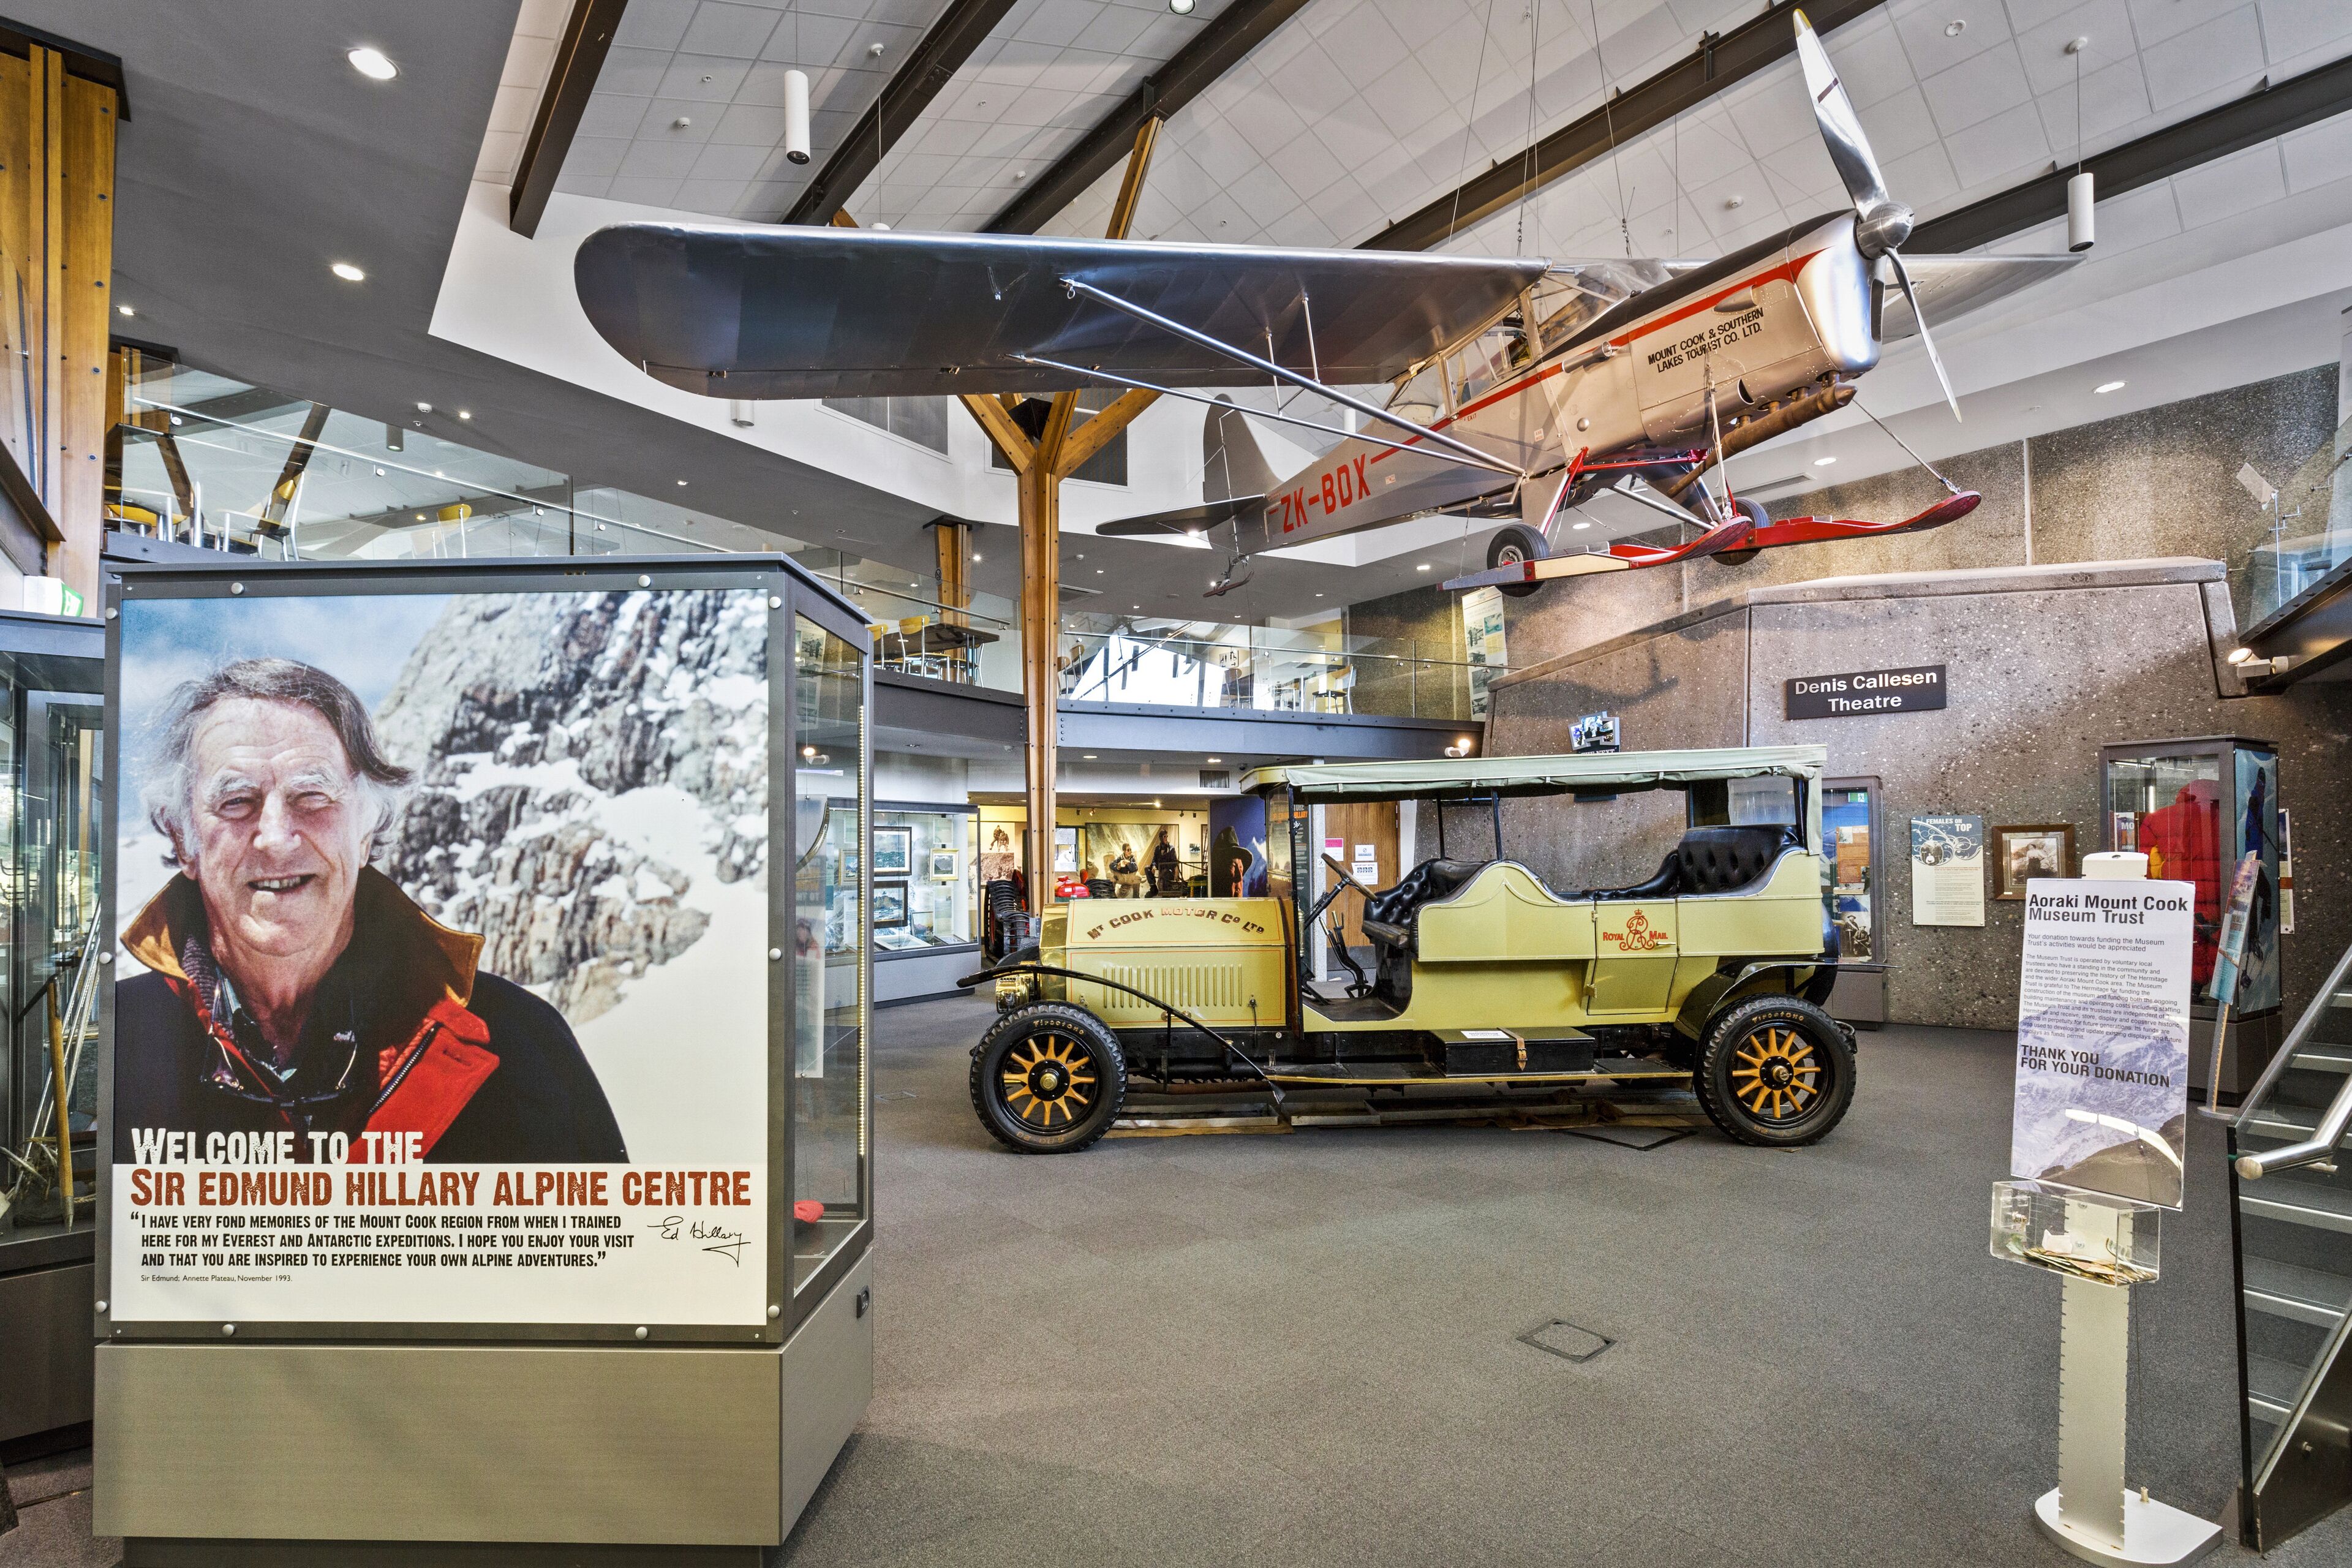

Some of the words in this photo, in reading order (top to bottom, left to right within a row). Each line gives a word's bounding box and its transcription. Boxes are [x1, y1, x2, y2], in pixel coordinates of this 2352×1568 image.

[1648, 344, 1676, 365] MOUNT
[1680, 332, 1705, 351] COOK
[1709, 328, 1716, 339] &
[1717, 307, 1764, 335] SOUTHERN
[1657, 355, 1683, 373] LAKES
[1685, 339, 1721, 361] TOURIST
[1724, 331, 1740, 345] CO.
[1743, 322, 1762, 339] LTD.
[1468, 413, 1477, 421] EXIT
[1281, 453, 1371, 533] ZK-BDX
[1795, 678, 1847, 695] Denis
[1853, 672, 1937, 690] Callesen
[1828, 695, 1902, 712] Theatre
[1954, 823, 1972, 832] TOP
[2029, 894, 2078, 908] Aoraki
[2085, 895, 2136, 910] Mount
[2144, 896, 2188, 911] Cook
[1109, 908, 1155, 929] COOK
[1161, 907, 1218, 920] MOTOR
[1242, 921, 1265, 934] LTD
[2029, 908, 2095, 922] Museum
[2101, 910, 2144, 924] Trust
[1603, 932, 1624, 941] ROYAL
[1649, 930, 1668, 940] MAIL
[2108, 944, 2146, 953] appreciated
[2021, 1044, 2065, 1060] THANK
[2070, 1050, 2098, 1065] YOU
[2021, 1057, 2046, 1071] FOR
[2052, 1060, 2089, 1077] YOUR
[2094, 1066, 2169, 1088] DONATION
[131, 1128, 295, 1164] WELCOME
[307, 1131, 350, 1164] TO
[361, 1131, 423, 1164] THE
[131, 1169, 185, 1207] SIR
[199, 1172, 333, 1207] EDMUND
[346, 1172, 481, 1207] HILLARY
[493, 1172, 609, 1207] ALPINE
[623, 1172, 752, 1207] CENTRE
[150, 1215, 179, 1229] HAVE
[183, 1215, 213, 1229] VERY
[217, 1215, 246, 1229] FOND
[251, 1215, 311, 1229] MEMORIES
[315, 1215, 330, 1229] OF
[334, 1215, 356, 1229] THE
[360, 1214, 402, 1229] MOUNT
[406, 1214, 437, 1229] COOK
[442, 1216, 483, 1229] REGION
[488, 1216, 520, 1229] FROM
[524, 1216, 559, 1229] WHEN
[563, 1216, 567, 1229] I
[571, 1216, 622, 1229] TRAINED
[142, 1235, 172, 1248] HERE
[176, 1235, 198, 1248] FOR
[202, 1235, 219, 1248] MY
[224, 1234, 276, 1248] EVEREST
[280, 1235, 303, 1248] AND
[307, 1234, 372, 1248] ANTARCTIC
[377, 1235, 455, 1248] EXPEDITIONS.
[459, 1234, 464, 1248] I
[468, 1235, 498, 1248] HOPE
[502, 1235, 524, 1248] YOU
[529, 1235, 565, 1248] ENJOY
[570, 1235, 600, 1248] YOUR
[604, 1235, 635, 1248] VISIT
[141, 1254, 165, 1267] AND
[169, 1254, 198, 1267] THAT
[203, 1254, 224, 1267] YOU
[228, 1254, 251, 1267] ARE
[255, 1254, 309, 1267] INSPIRED
[312, 1254, 328, 1267] TO
[332, 1254, 402, 1267] EXPERIENCE
[407, 1254, 437, 1267] YOUR
[441, 1254, 468, 1267] OWN
[472, 1254, 513, 1267] ALPINE
[518, 1251, 606, 1267] ADVENTURES.”
[211, 1275, 236, 1283] Plateau,
